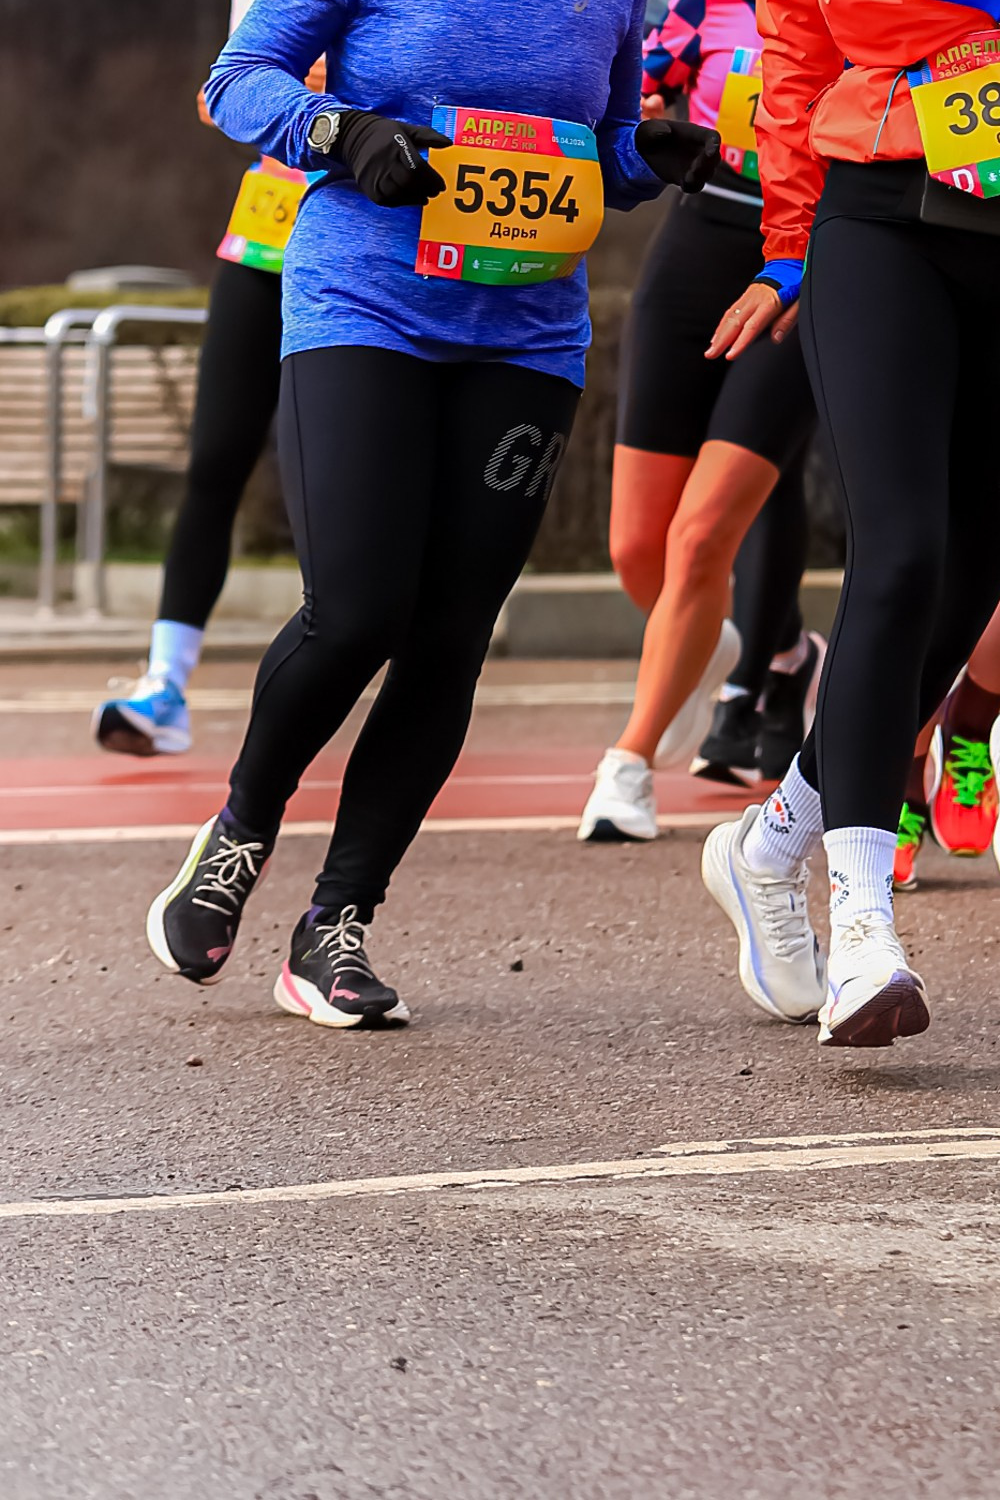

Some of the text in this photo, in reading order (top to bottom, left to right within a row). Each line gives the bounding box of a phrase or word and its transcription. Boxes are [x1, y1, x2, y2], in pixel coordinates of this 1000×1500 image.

[938, 61, 972, 79] забег
[983, 52, 992, 63] 5
[463, 116, 537, 139] АПРЕЛЬ
[461, 135, 498, 147] забег
[511, 138, 519, 150] 5
[521, 142, 537, 151] км
[551, 135, 585, 147] 05.04.2026
[952, 168, 975, 193] D
[454, 164, 580, 223] 5354
[489, 222, 538, 240] Дарья
[437, 245, 459, 270] D
